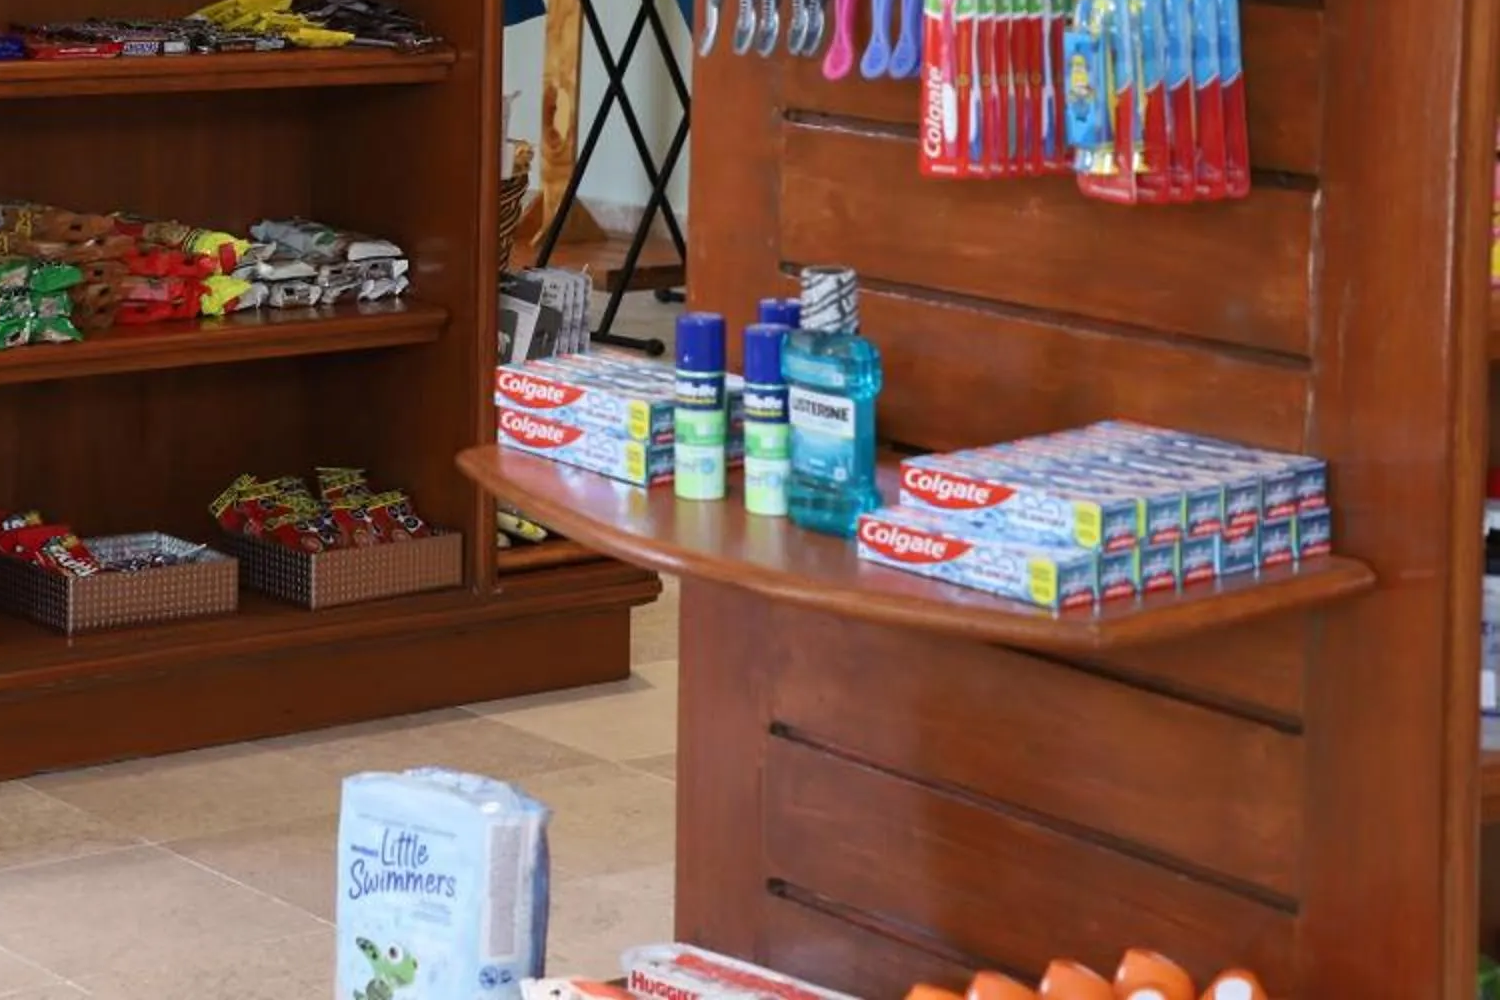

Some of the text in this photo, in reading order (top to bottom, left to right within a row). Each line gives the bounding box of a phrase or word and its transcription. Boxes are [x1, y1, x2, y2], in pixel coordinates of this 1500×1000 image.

[922, 64, 943, 158] Colgate
[499, 373, 565, 403] Colgate
[501, 411, 565, 443] Colgate
[904, 467, 991, 505] Colgate
[861, 520, 948, 559] Colgate
[381, 827, 429, 869] Little
[348, 858, 457, 900] Swimmers
